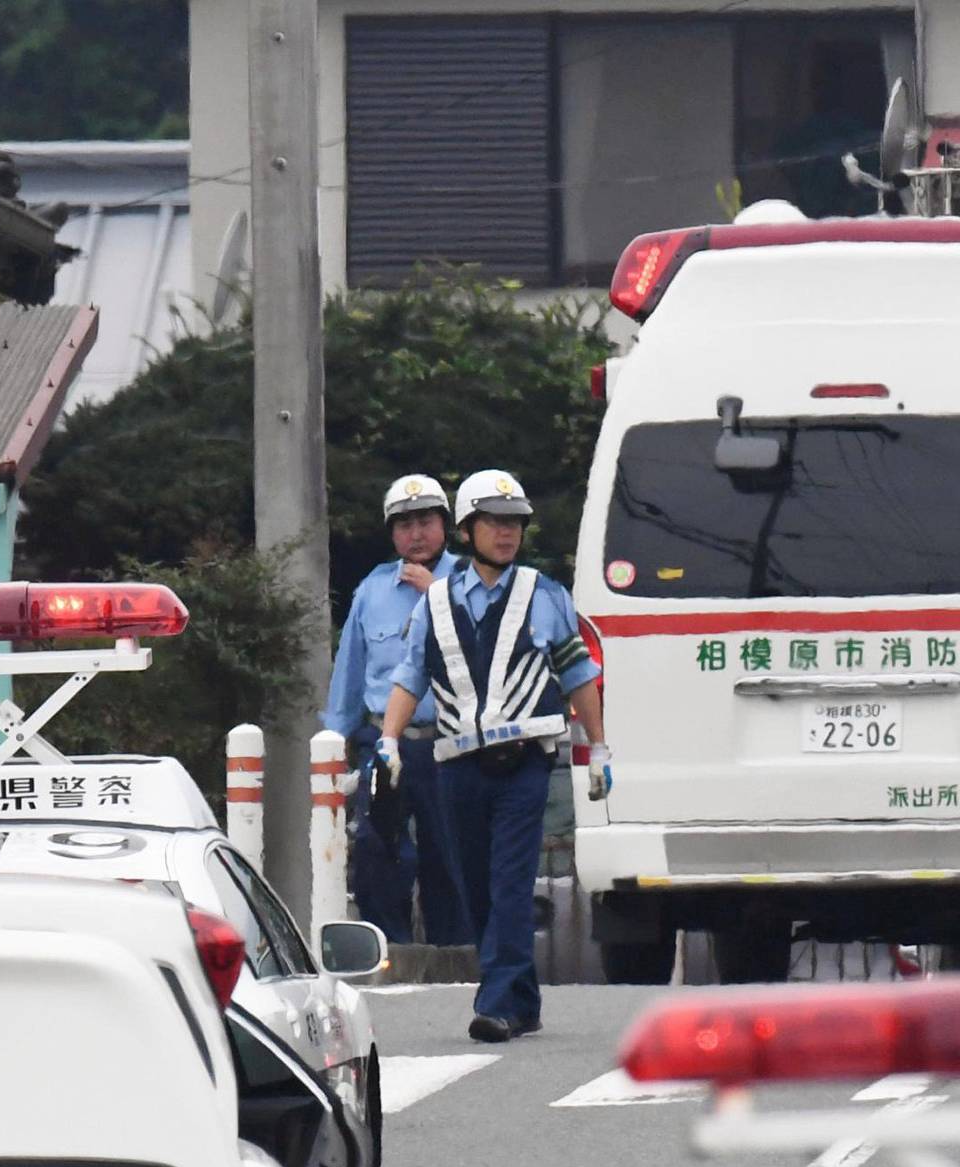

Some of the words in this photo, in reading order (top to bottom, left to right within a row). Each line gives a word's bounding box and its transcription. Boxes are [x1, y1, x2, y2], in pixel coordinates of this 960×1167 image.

[696, 637, 957, 671] 相模原市消防
[887, 784, 959, 808] 派出所
